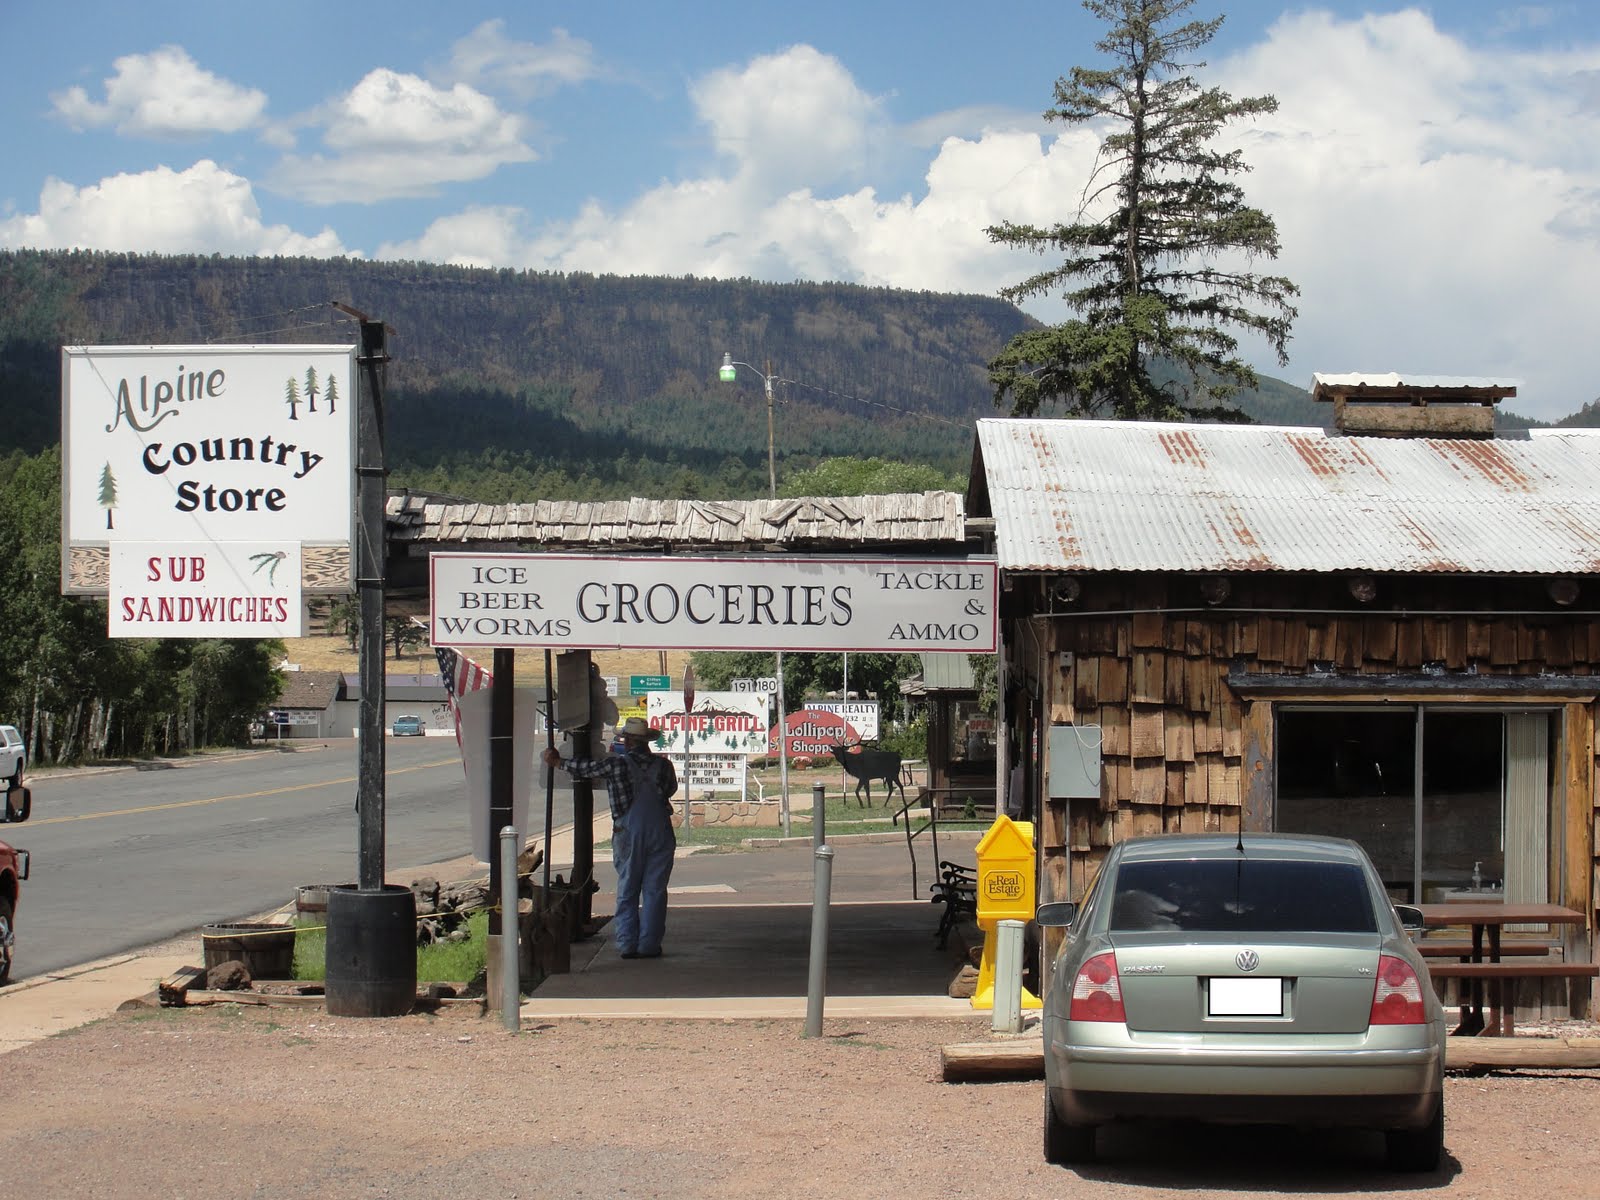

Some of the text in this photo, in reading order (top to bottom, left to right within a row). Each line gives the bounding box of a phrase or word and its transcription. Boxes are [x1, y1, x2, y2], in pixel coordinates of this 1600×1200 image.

[105, 364, 226, 433] Alpine
[142, 435, 323, 479] Country
[174, 480, 286, 512] Store
[147, 557, 205, 582] SUB
[472, 566, 528, 584] ICE
[876, 572, 984, 591] TACKLE
[121, 597, 288, 623] SANDWICHES
[459, 592, 544, 610] BEER
[576, 582, 852, 626] GROCERIES
[964, 598, 987, 616] &
[439, 617, 572, 637] WORMS
[888, 623, 979, 641] AMMO
[734, 682, 751, 692] 191
[758, 680, 776, 691] 180
[650, 716, 765, 732] ALPINE GRILL
[785, 721, 844, 740] Lollipop
[989, 884, 1020, 894] Estate
[996, 875, 1019, 885] Real
[1123, 965, 1166, 974] PASSAT
